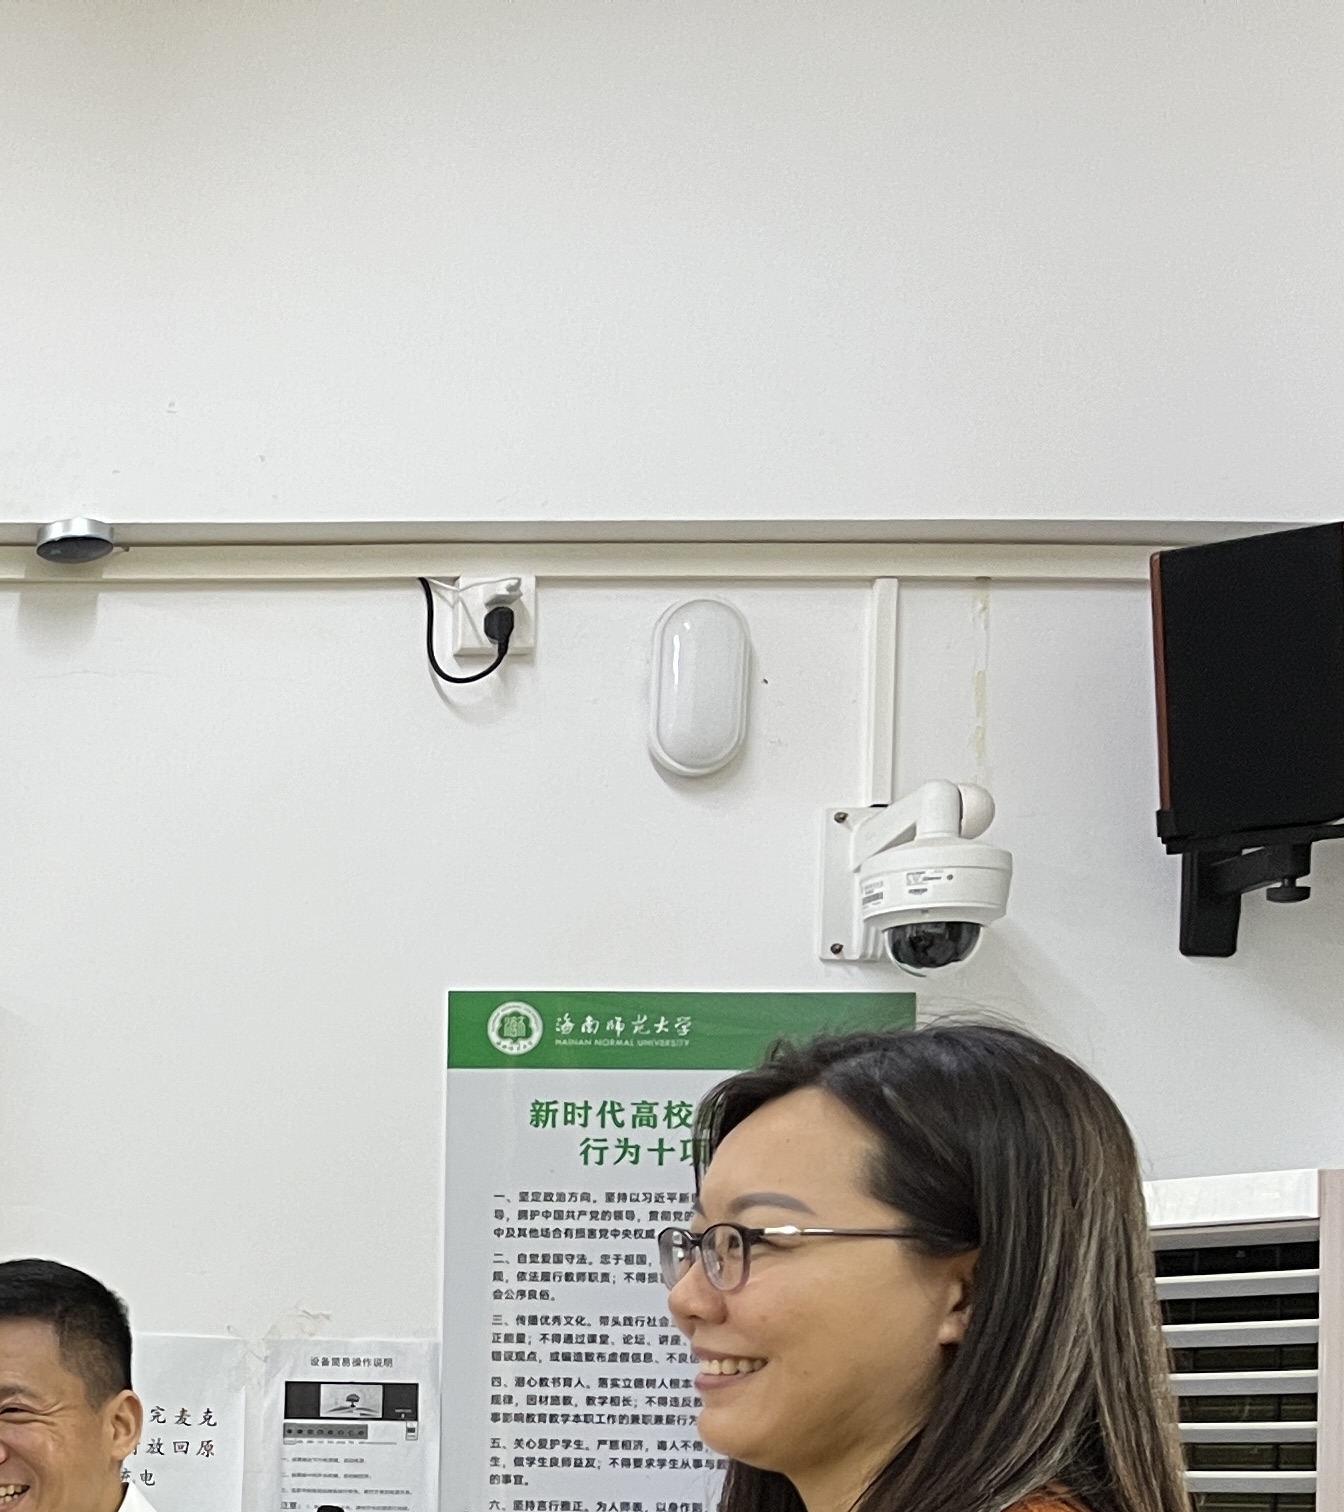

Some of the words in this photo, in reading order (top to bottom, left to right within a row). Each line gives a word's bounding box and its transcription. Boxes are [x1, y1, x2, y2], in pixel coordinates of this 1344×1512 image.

[555, 1013, 692, 1037] 海南师范大学
[594, 1039, 634, 1047] NORMAL
[637, 1039, 690, 1047] UNIVERSITY
[529, 1099, 694, 1129] 新时代高校
[148, 1406, 217, 1427] 完麦克
[133, 1437, 215, 1458] 放回原
